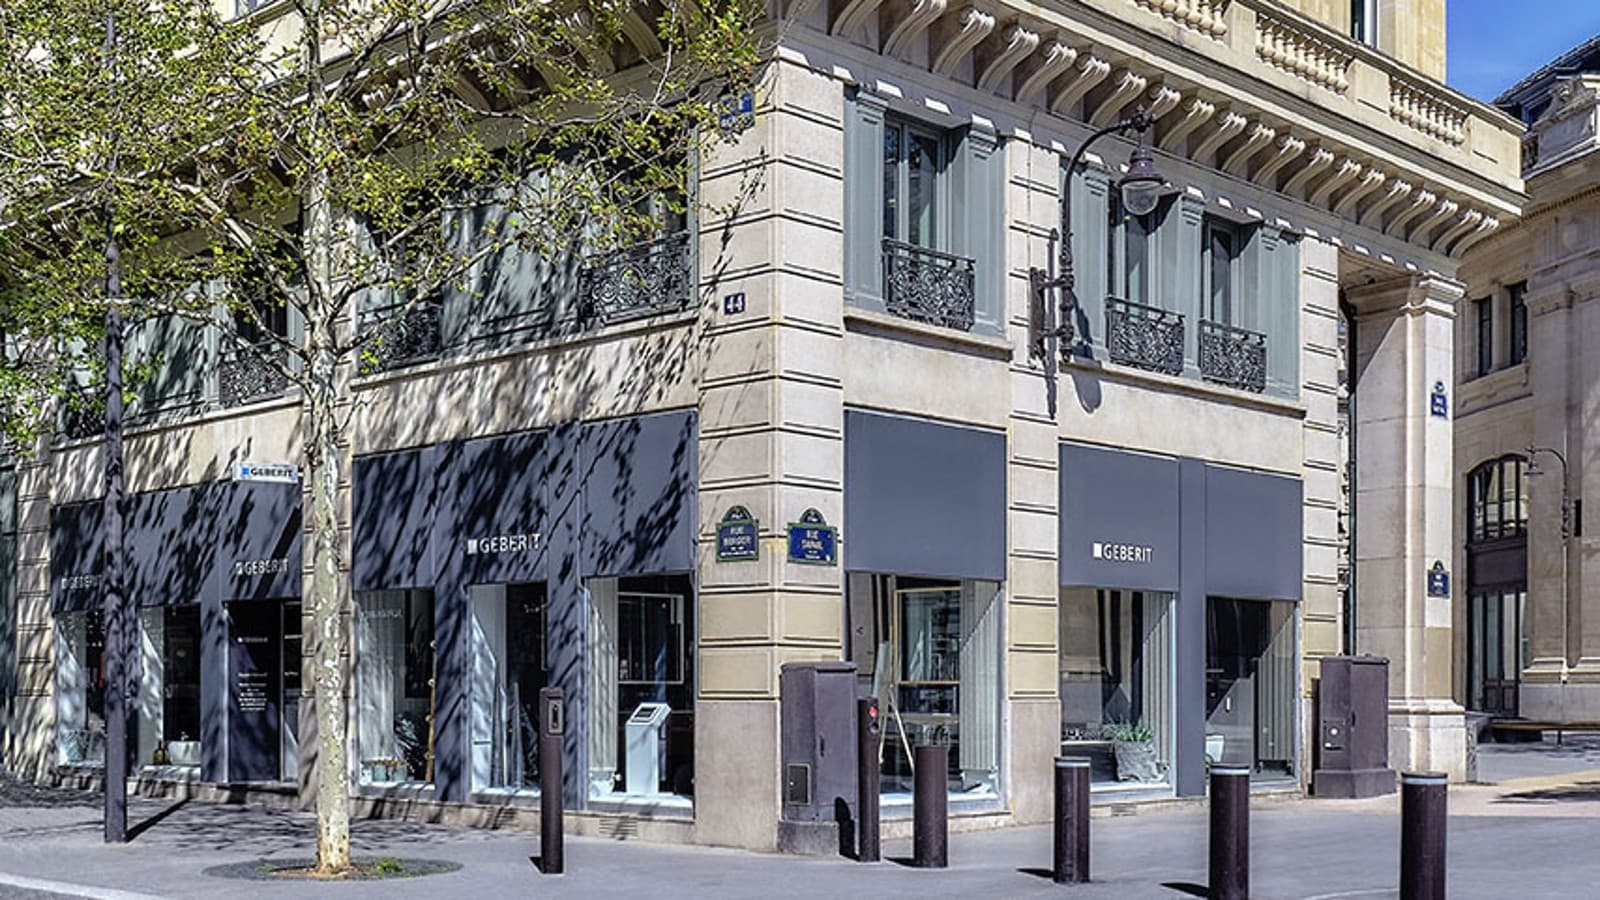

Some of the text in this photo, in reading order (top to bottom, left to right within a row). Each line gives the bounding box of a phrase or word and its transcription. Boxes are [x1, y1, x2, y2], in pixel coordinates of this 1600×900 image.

[726, 294, 743, 312] 44
[480, 533, 540, 554] GEBERIT
[1103, 544, 1152, 563] GEBERIT
[245, 559, 288, 576] GEBERIT
